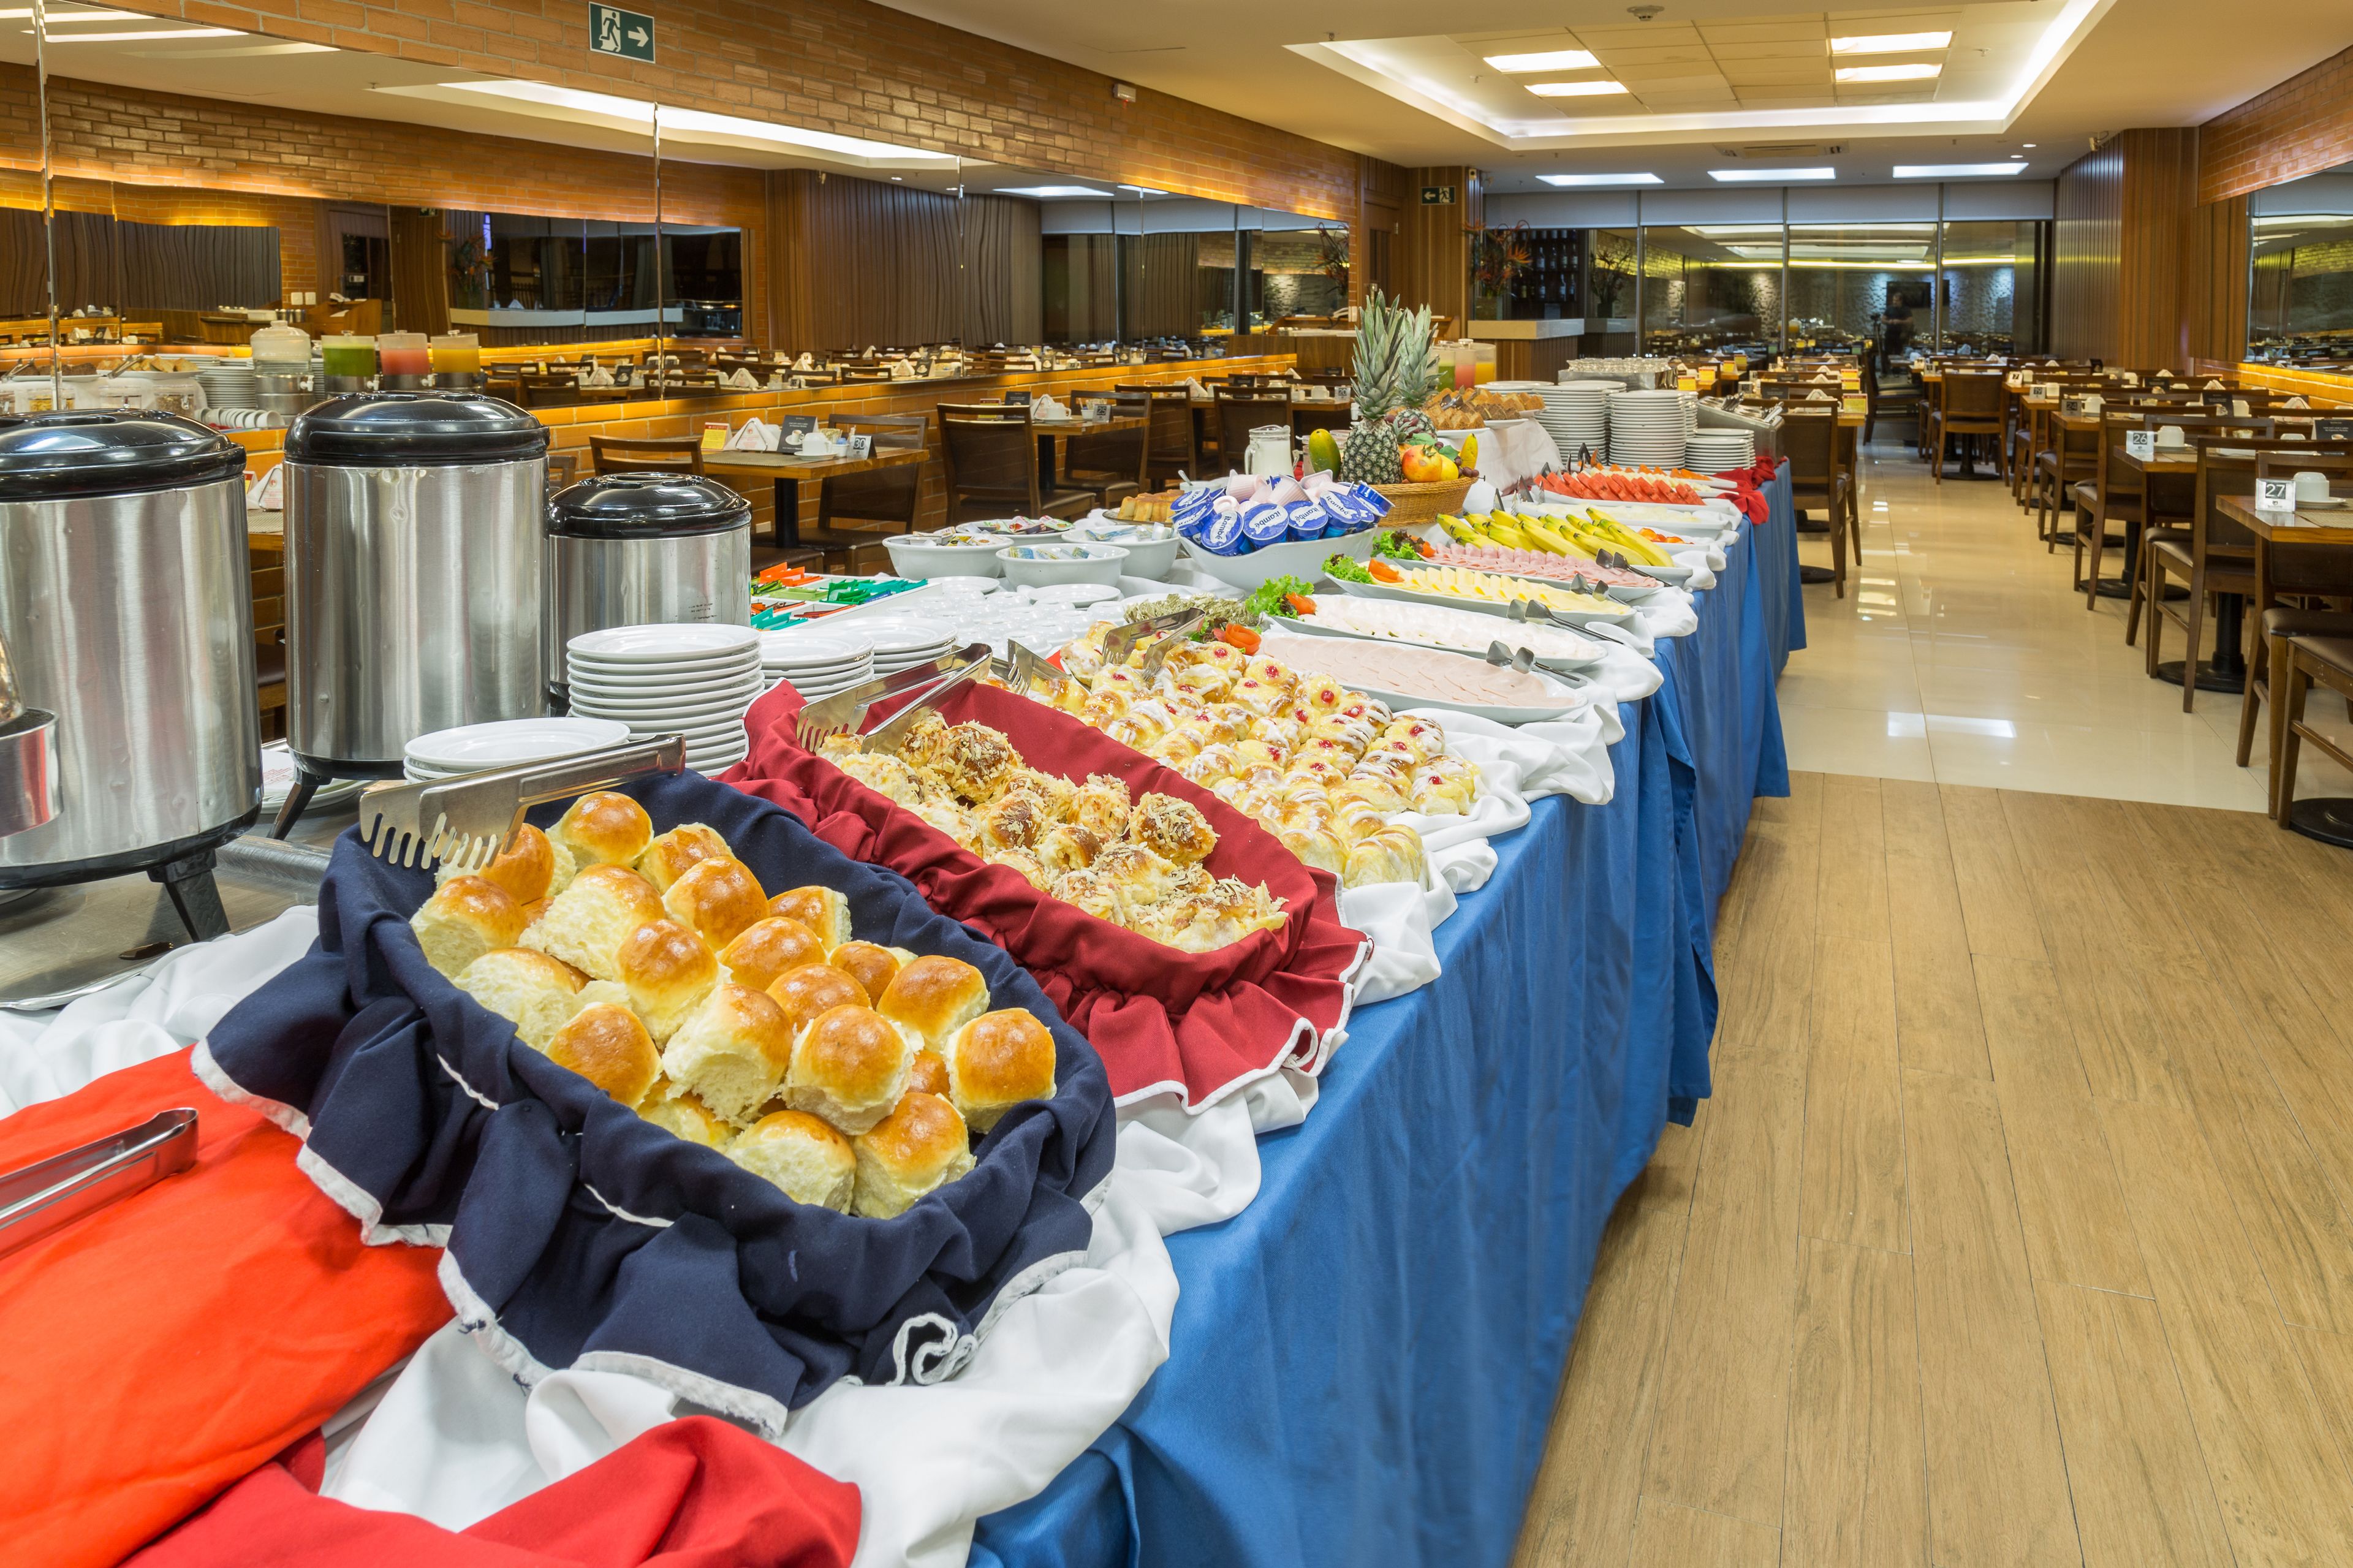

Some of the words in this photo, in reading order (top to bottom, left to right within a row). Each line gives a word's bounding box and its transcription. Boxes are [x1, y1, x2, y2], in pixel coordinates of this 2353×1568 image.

[854, 438, 865, 449] 30
[2134, 434, 2147, 444] 26
[2265, 483, 2285, 497] 27
[1326, 495, 1349, 515] itambé
[1254, 510, 1281, 528] itambé
[1295, 507, 1320, 523] itambé
[1216, 516, 1232, 540] itambé
